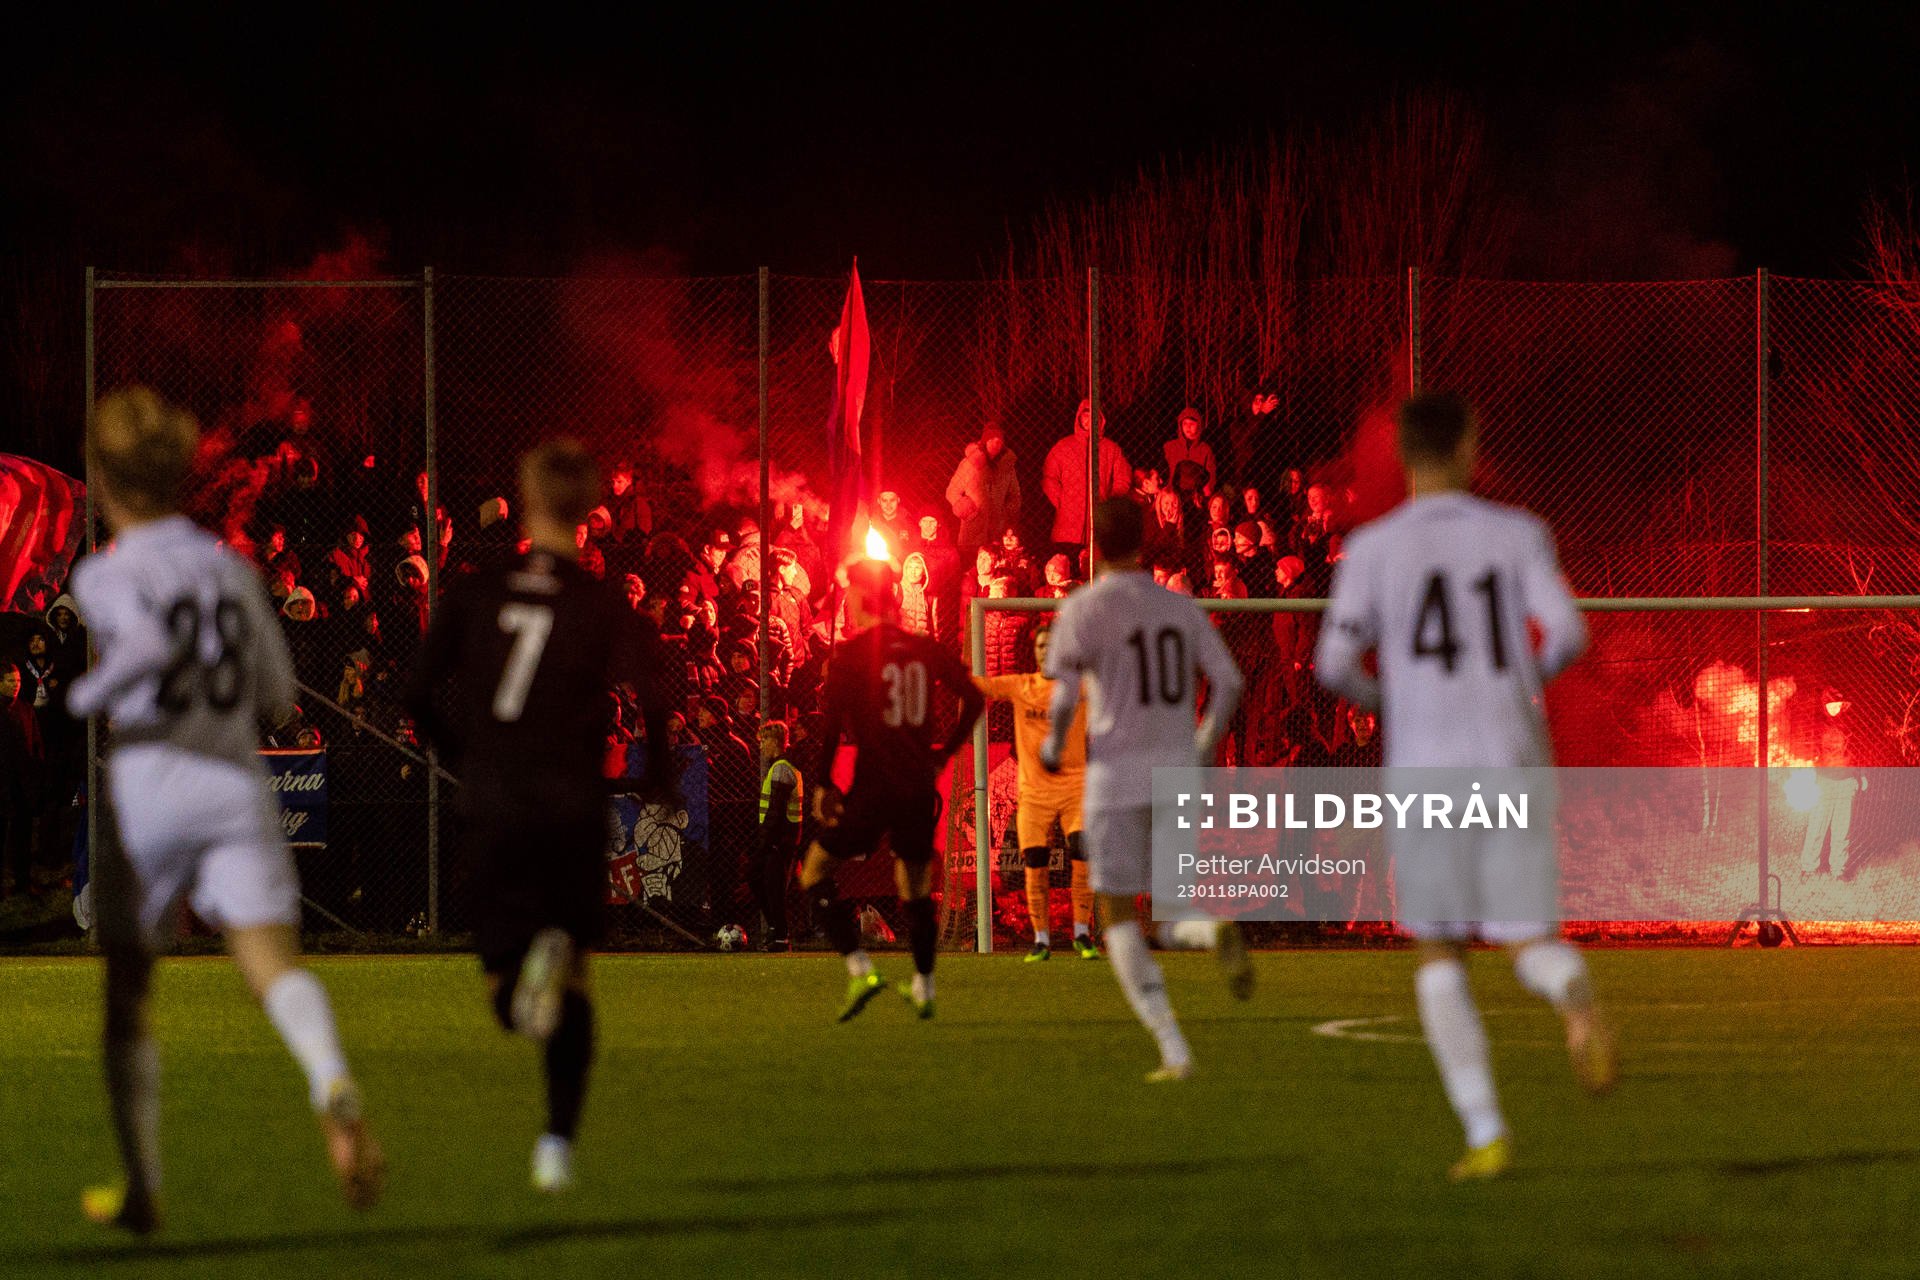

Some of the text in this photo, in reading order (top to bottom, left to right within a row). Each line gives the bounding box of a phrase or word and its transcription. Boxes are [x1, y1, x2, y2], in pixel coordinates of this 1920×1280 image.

[157, 590, 246, 715] 28
[491, 601, 555, 723] 7
[1126, 627, 1186, 705] 10
[1411, 569, 1508, 672] 41
[881, 660, 928, 728] 30
